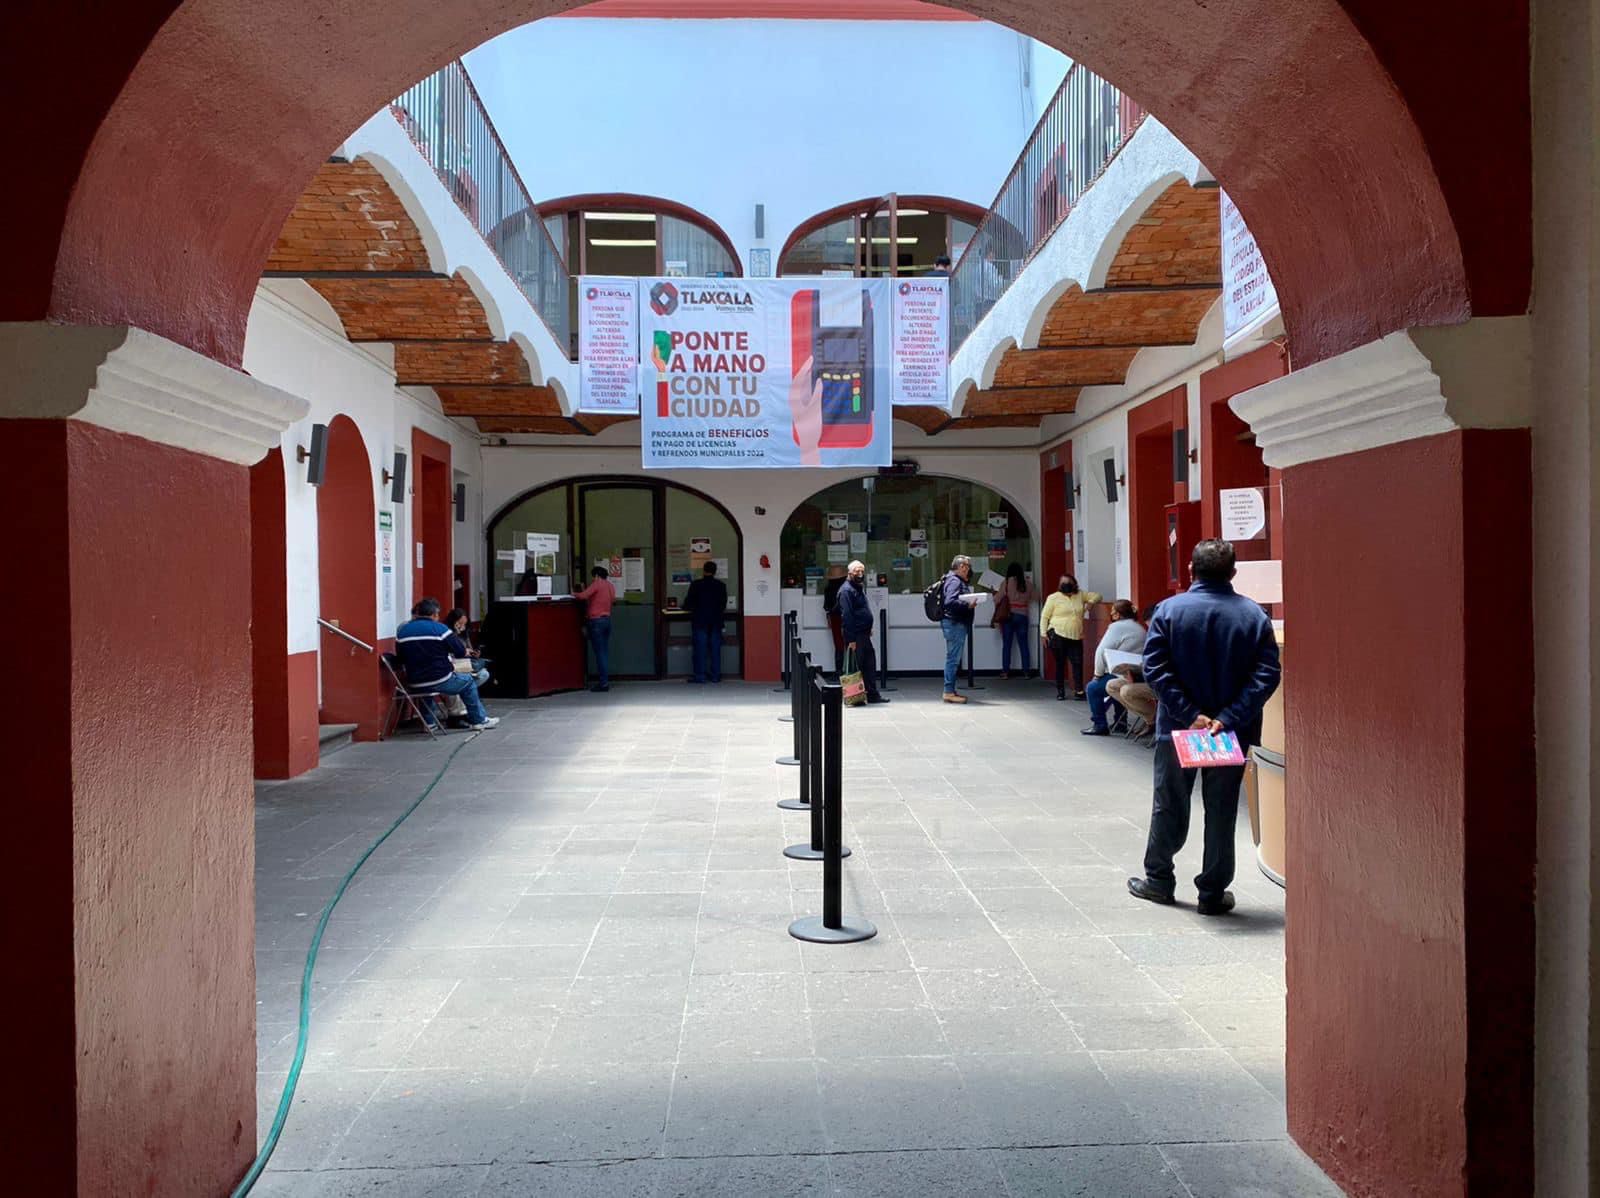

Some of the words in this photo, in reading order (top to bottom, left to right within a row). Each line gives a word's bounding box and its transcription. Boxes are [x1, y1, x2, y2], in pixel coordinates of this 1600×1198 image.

[681, 290, 754, 305] TLAXCALA
[670, 331, 749, 351] PONTE
[670, 353, 687, 373] A
[693, 353, 766, 374] MANO
[671, 375, 720, 396] CON
[727, 376, 758, 396] TU
[671, 398, 761, 418] CIUDAD
[651, 430, 694, 438] PROGRAMA
[708, 428, 770, 439] BENEFICIOS
[652, 440, 663, 448] EN
[664, 440, 685, 448] PAGO
[686, 440, 696, 448] DE
[697, 440, 737, 448] LICENCIAS
[657, 449, 699, 457] REFRENDOS
[699, 449, 746, 457] MUNICIPALES
